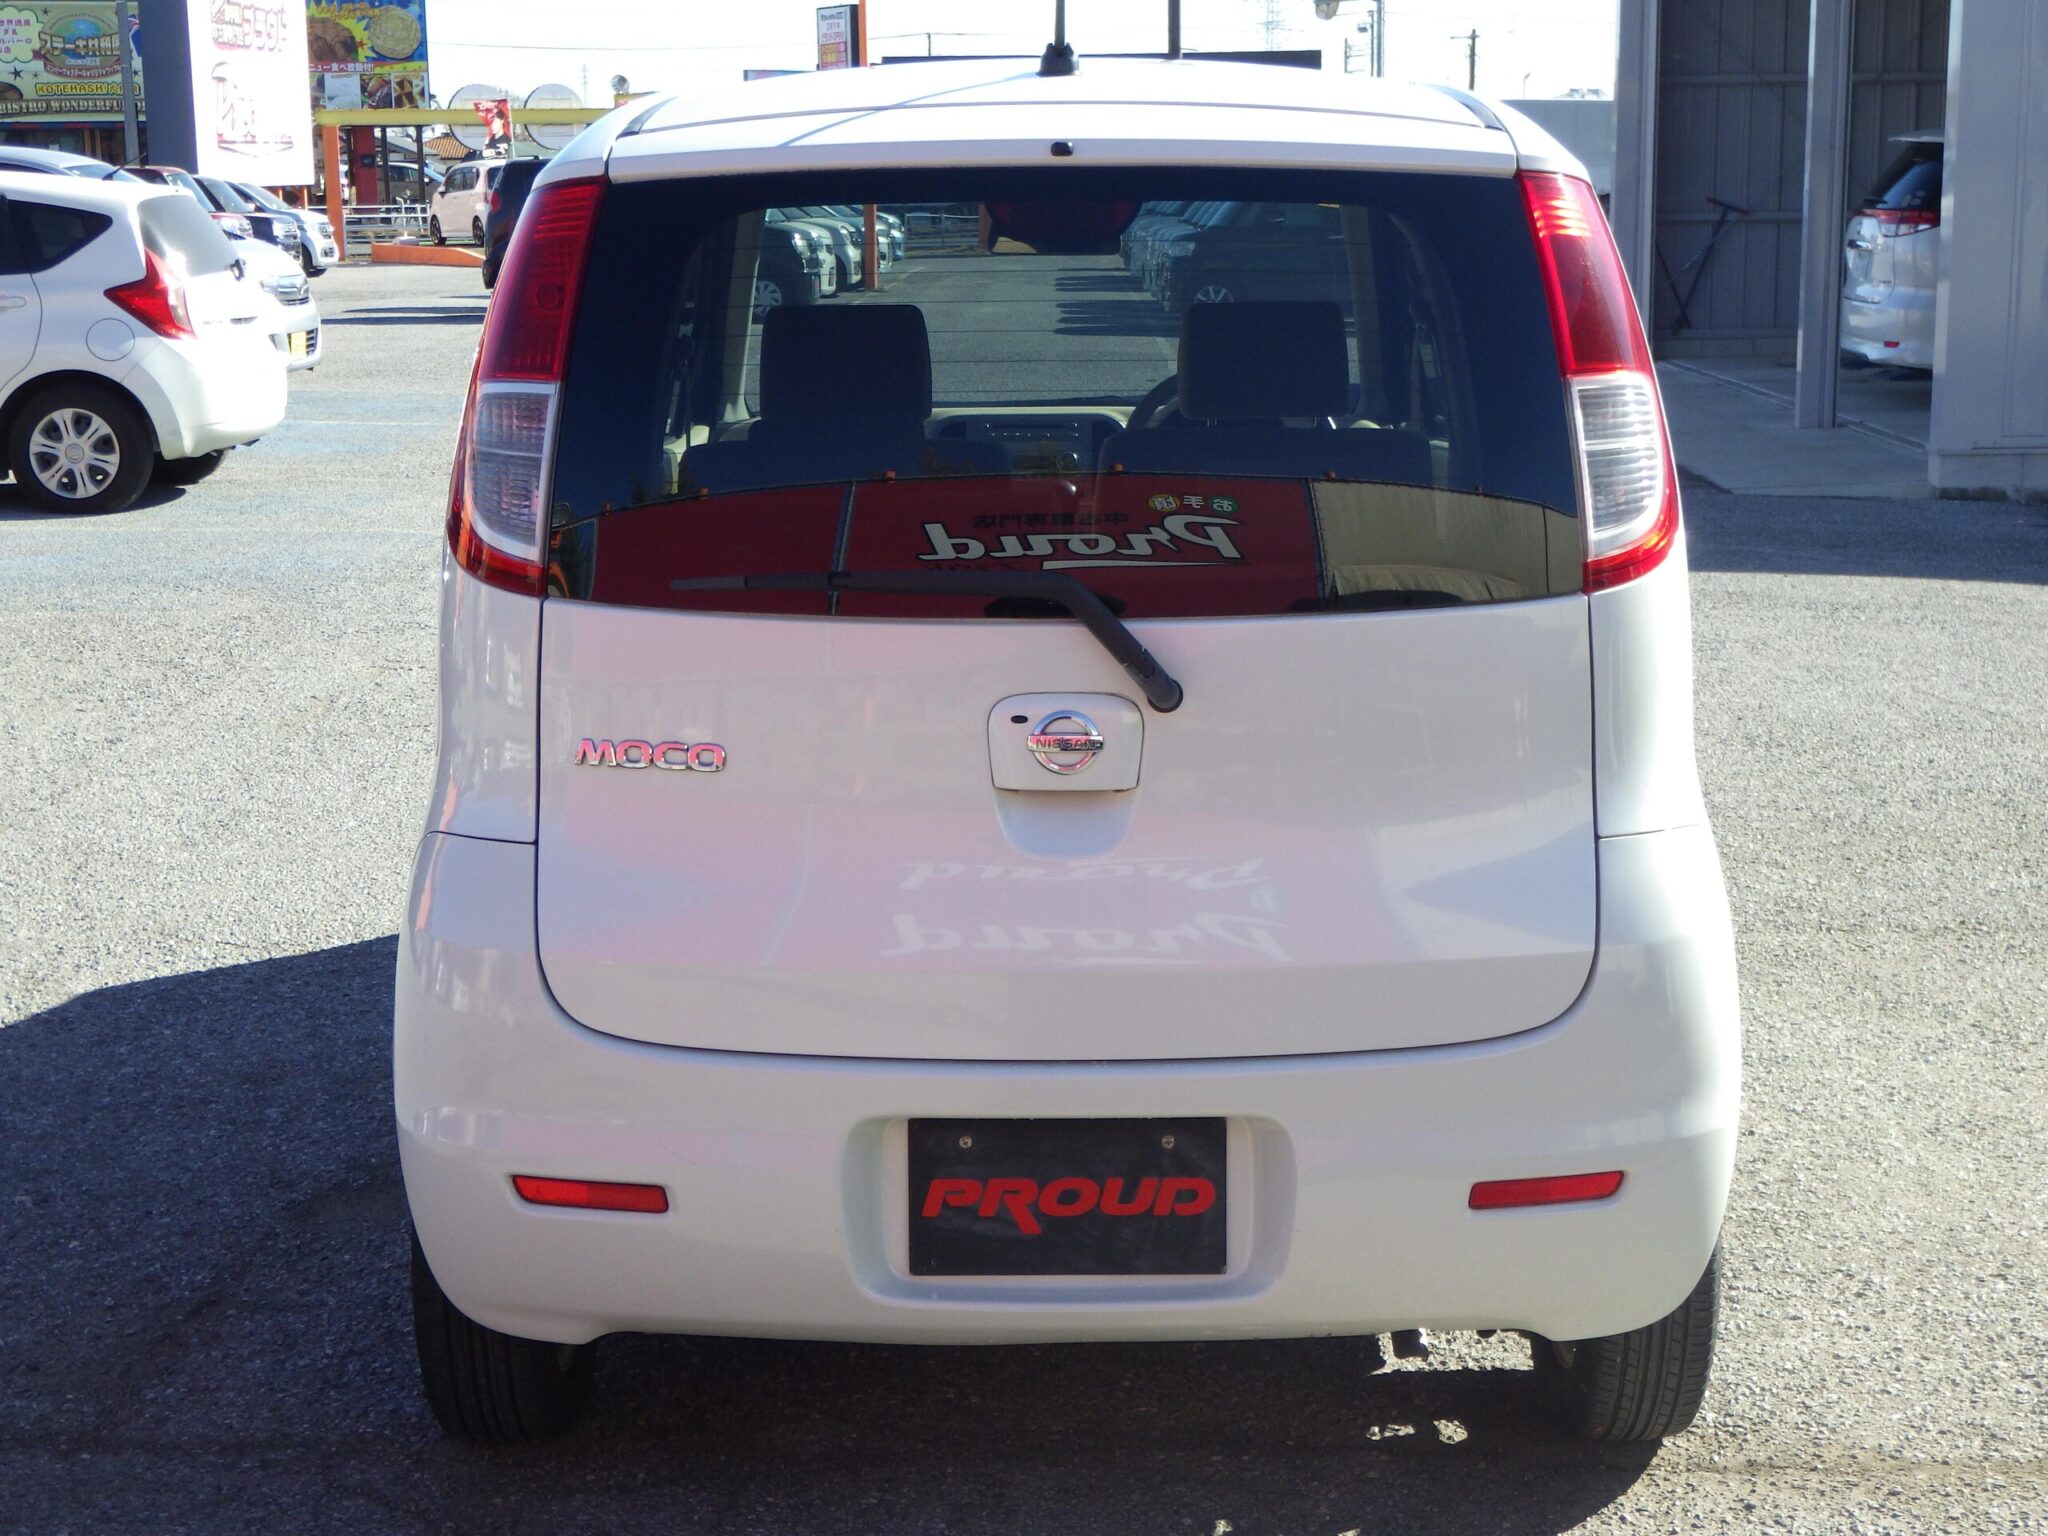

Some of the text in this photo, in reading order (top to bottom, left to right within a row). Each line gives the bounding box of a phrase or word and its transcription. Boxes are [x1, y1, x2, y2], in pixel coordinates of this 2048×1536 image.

[574, 737, 727, 773] MOCO
[1035, 738, 1097, 750] NISSAN
[921, 1176, 1217, 1236] PROUD
